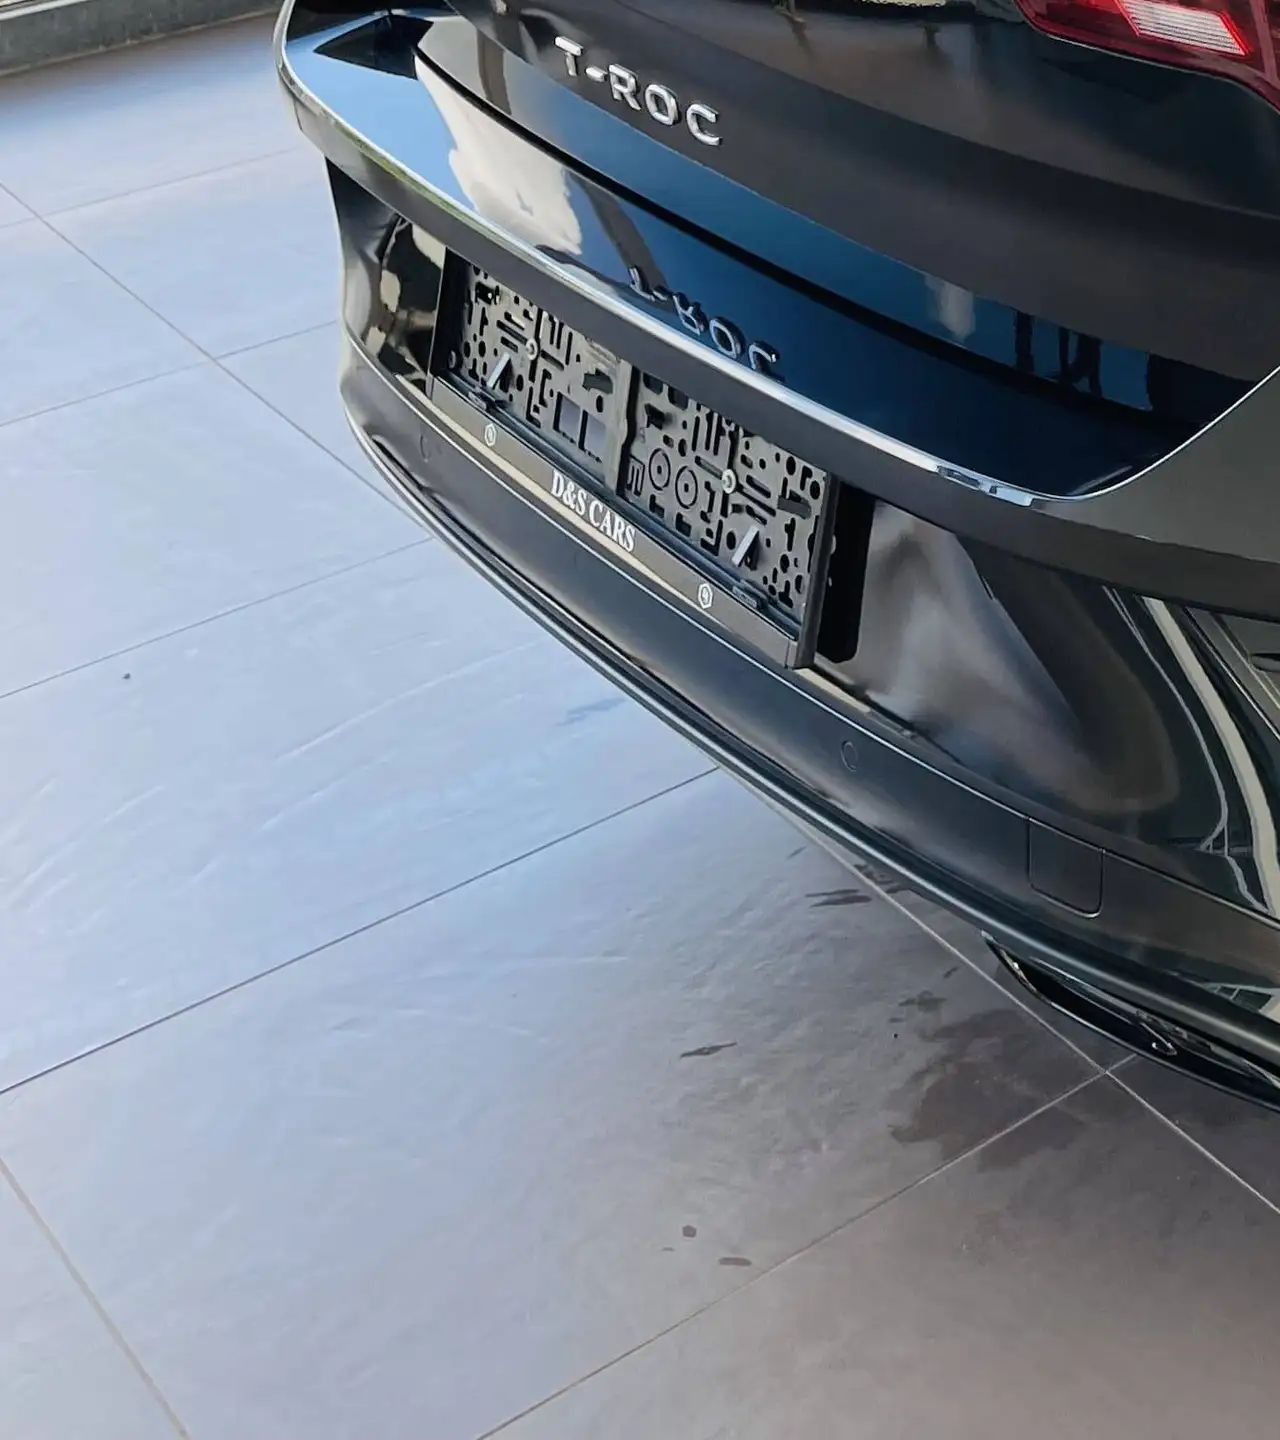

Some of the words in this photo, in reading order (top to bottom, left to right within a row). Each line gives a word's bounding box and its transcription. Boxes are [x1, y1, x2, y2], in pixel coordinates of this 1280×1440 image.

[554, 35, 723, 147] T-ROC
[551, 469, 587, 517] D&S
[589, 500, 636, 553] CARS
